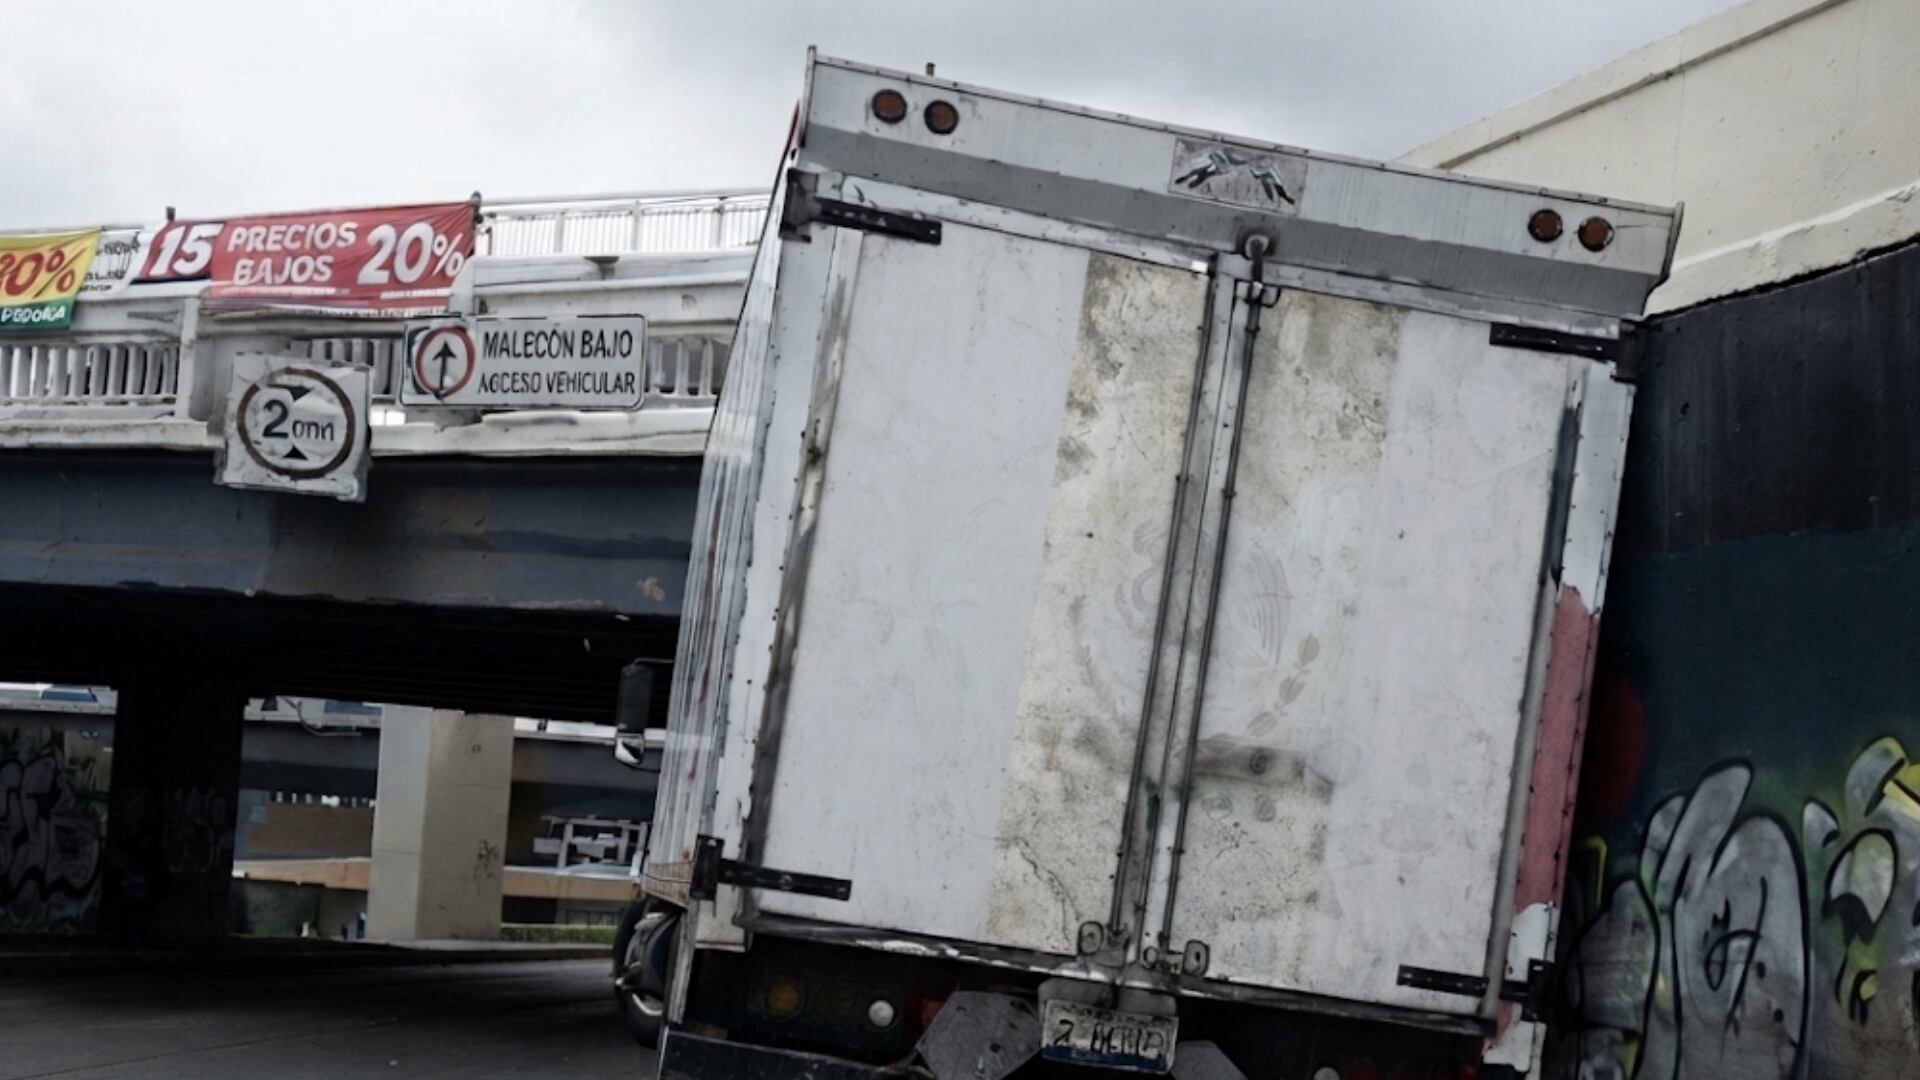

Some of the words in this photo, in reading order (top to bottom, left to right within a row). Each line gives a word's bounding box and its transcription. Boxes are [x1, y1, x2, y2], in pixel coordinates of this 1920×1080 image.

[149, 222, 225, 276] 15
[226, 221, 359, 252] PRECIOS
[357, 221, 465, 285] 20%
[233, 255, 335, 286] BAJOS
[482, 323, 574, 359] MALECÓN
[580, 330, 633, 359] BAJO
[546, 371, 635, 395] VEHICULAR
